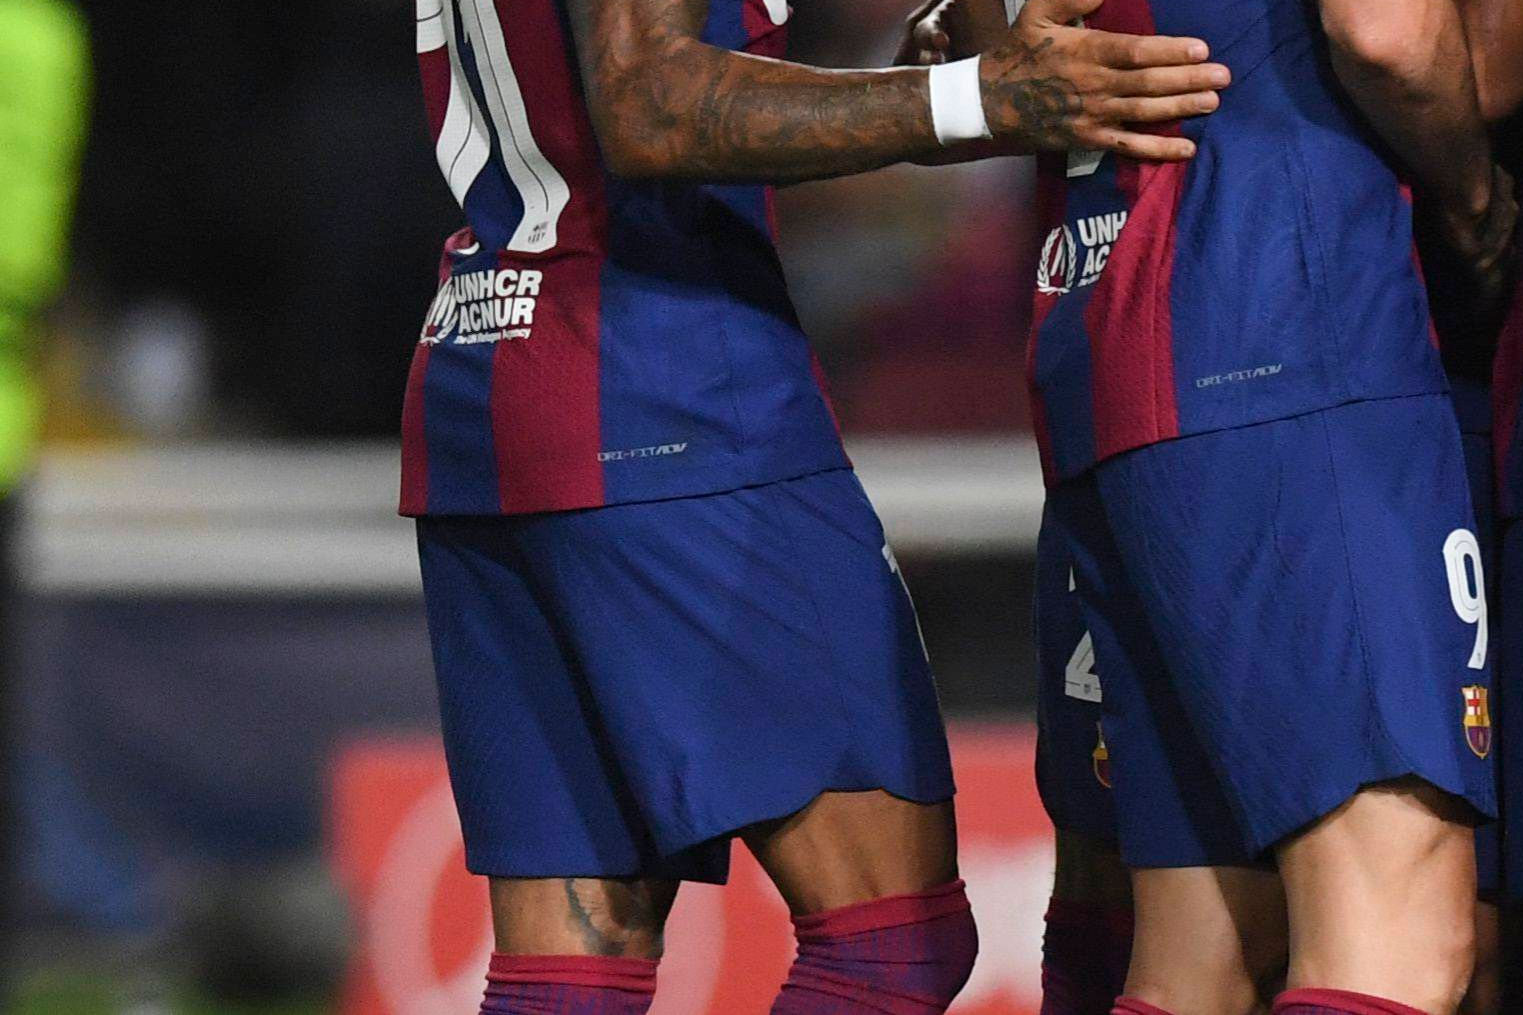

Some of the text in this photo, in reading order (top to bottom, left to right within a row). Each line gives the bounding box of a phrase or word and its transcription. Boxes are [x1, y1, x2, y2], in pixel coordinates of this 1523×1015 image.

[454, 269, 543, 304] UNHCR
[458, 297, 536, 334] ACNUR
[1442, 528, 1489, 670] 9
